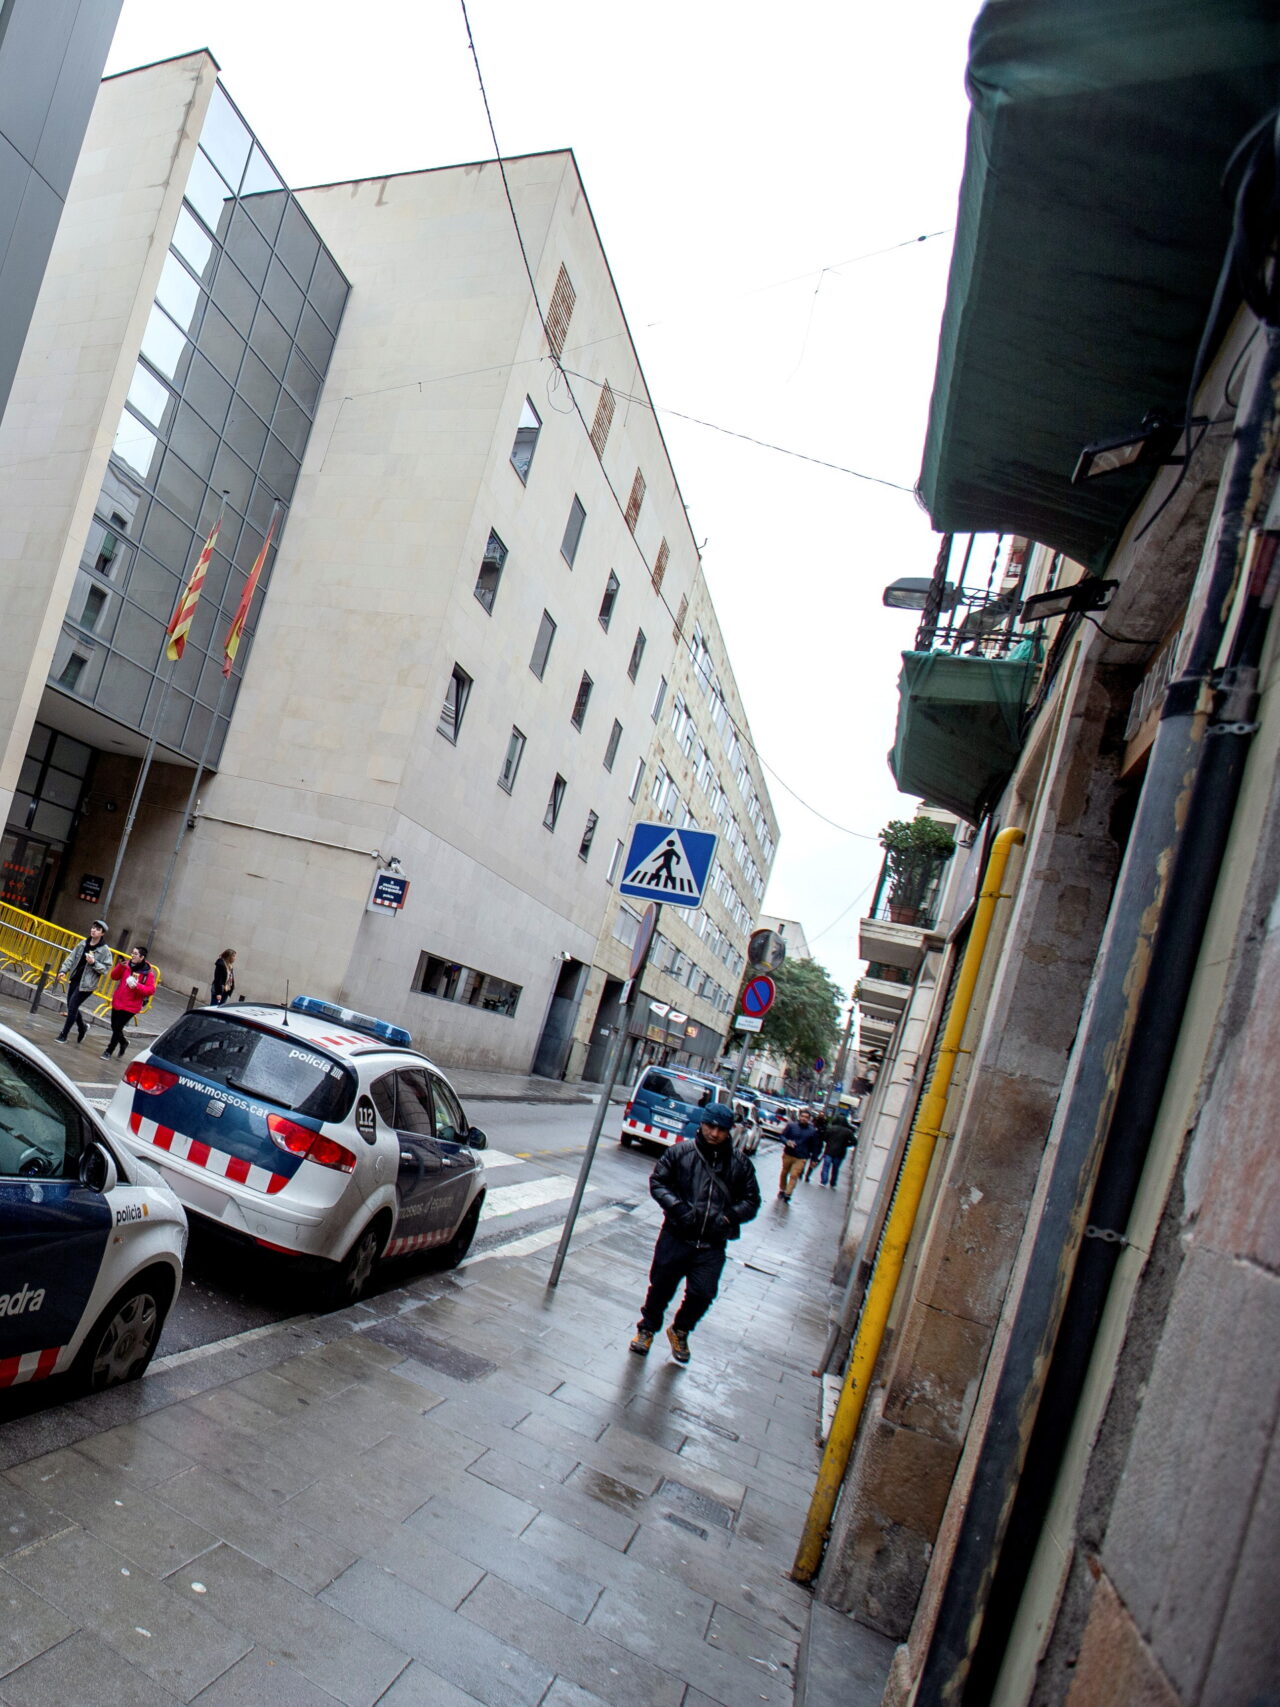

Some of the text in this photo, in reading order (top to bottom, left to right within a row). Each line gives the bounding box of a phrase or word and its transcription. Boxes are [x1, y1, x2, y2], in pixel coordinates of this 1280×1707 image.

[289, 1049, 330, 1073] policia
[178, 1075, 271, 1119] www.mossos.cat
[359, 1107, 374, 1126] 112
[116, 1204, 142, 1227] policia
